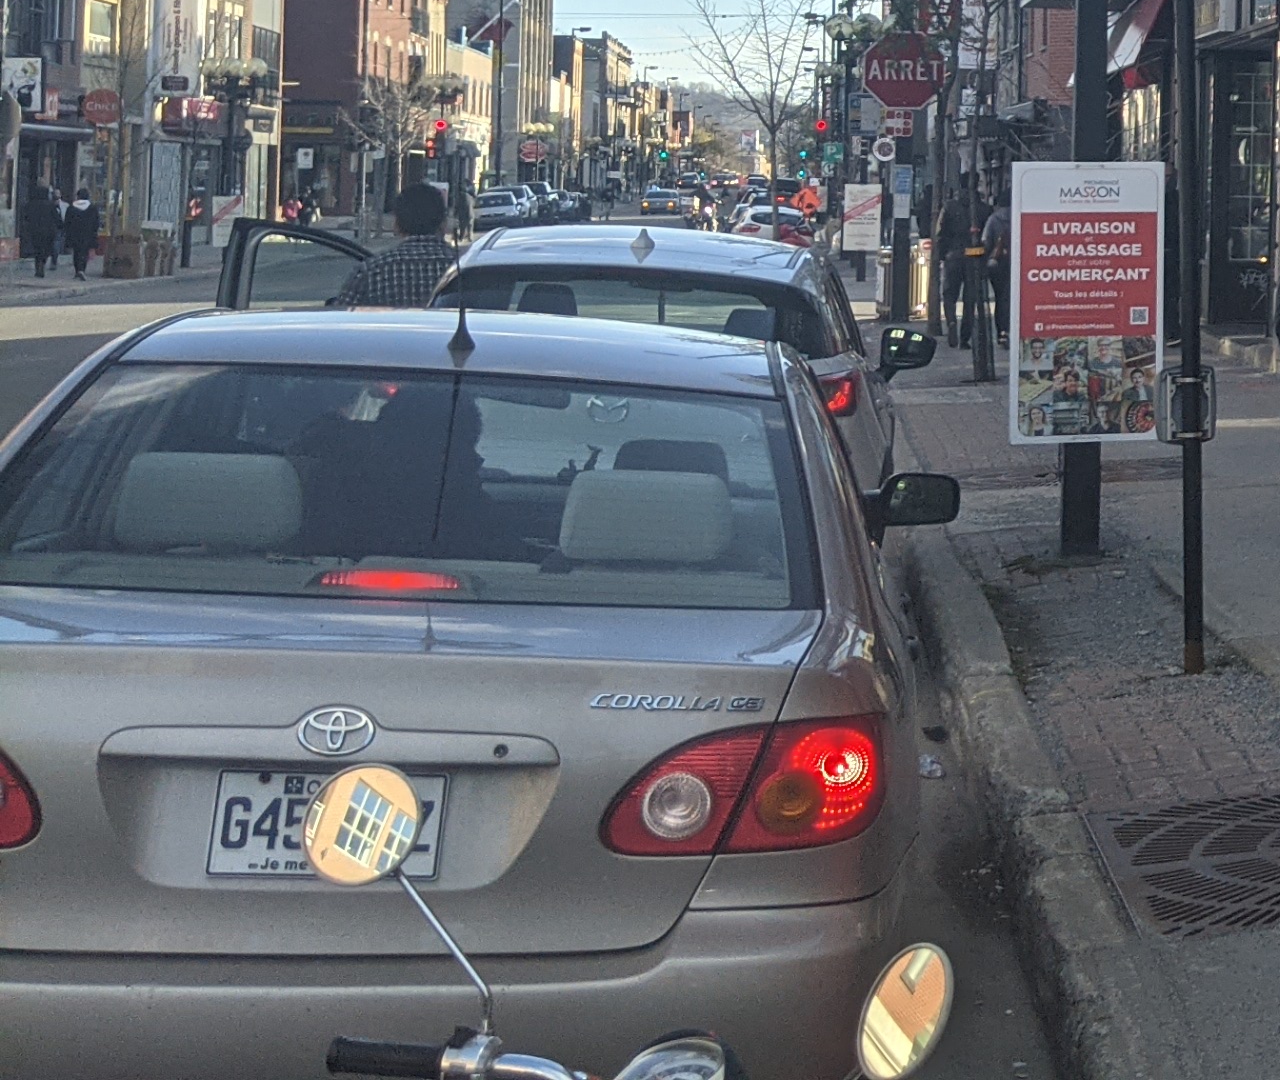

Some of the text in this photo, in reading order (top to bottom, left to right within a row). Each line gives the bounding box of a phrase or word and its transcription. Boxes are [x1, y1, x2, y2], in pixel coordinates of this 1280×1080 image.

[867, 56, 942, 82] ARRÊT
[1059, 186, 1120, 198] MASSON
[1042, 222, 1136, 235] LIVRAISON
[1036, 243, 1142, 258] RAMASSAGE
[1067, 258, 1111, 266] chez votre
[1027, 267, 1150, 282] COMMERÇANT
[1054, 290, 1073, 298] Tous
[1075, 290, 1087, 298] les
[1089, 290, 1118, 298] détails
[590, 693, 722, 711] COROLLA
[260, 858, 280, 870] Je
